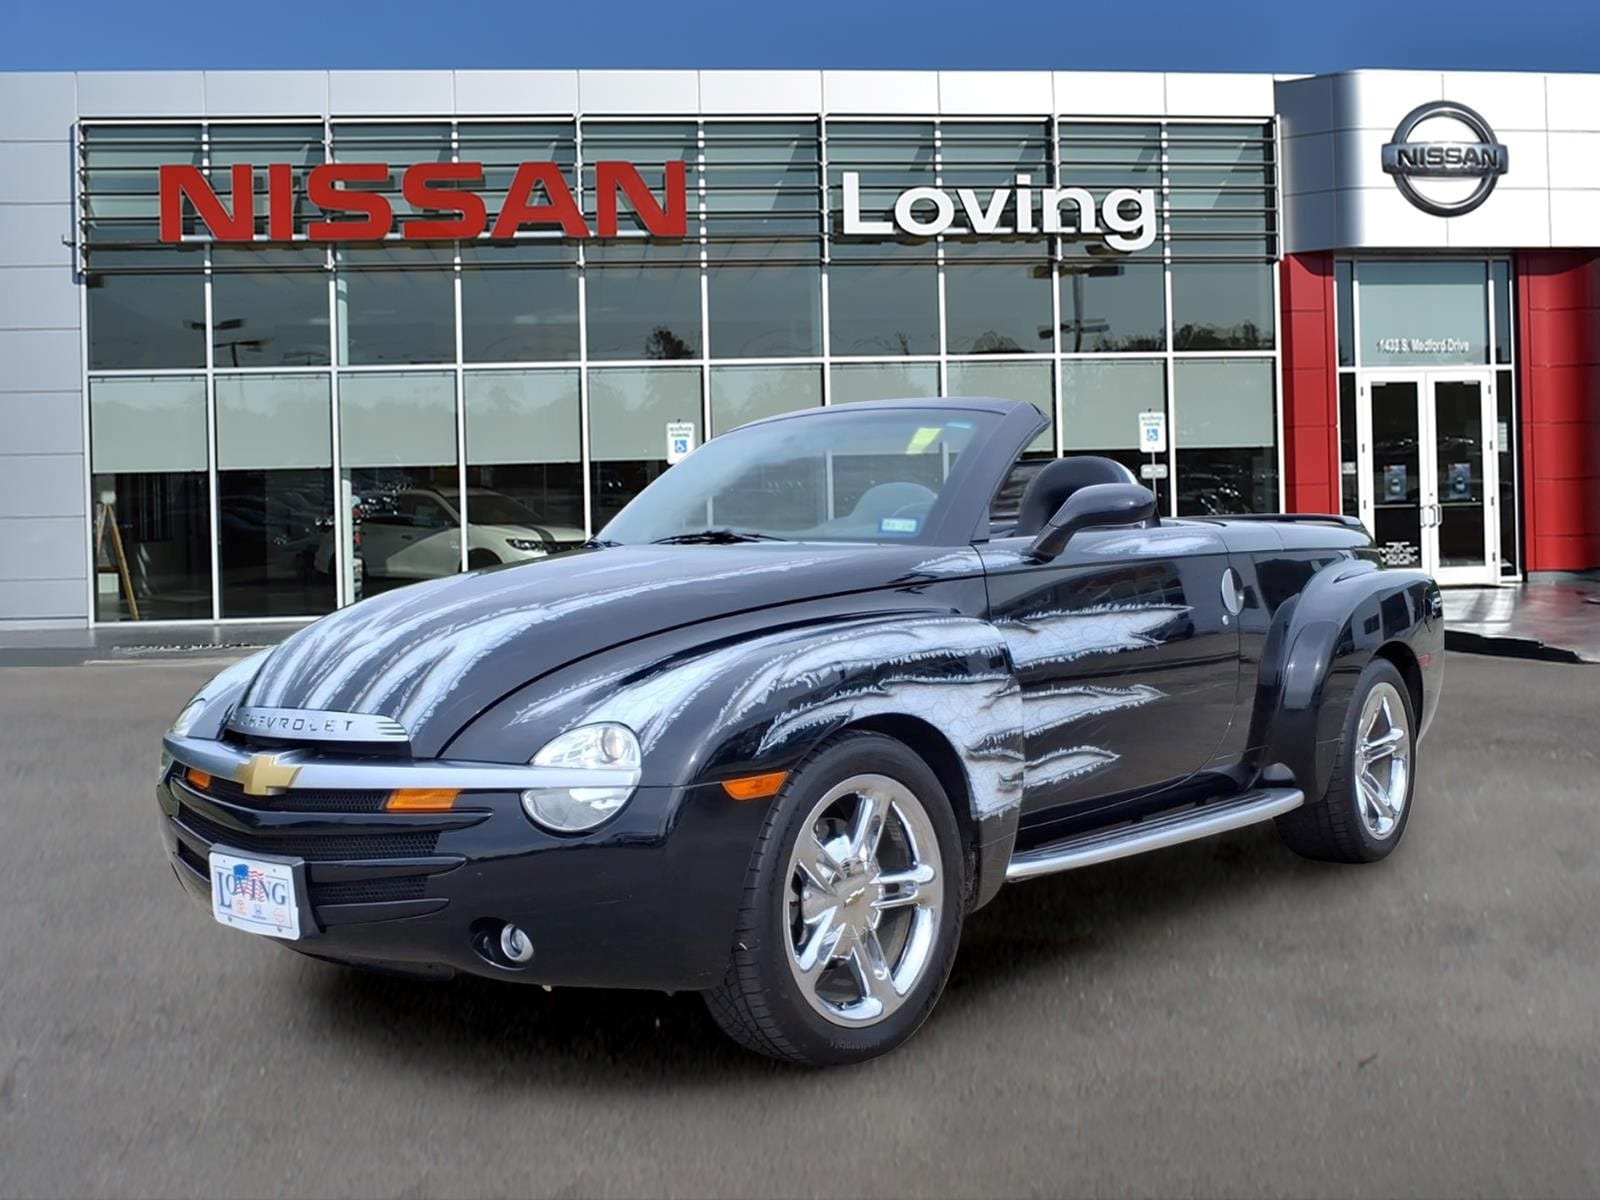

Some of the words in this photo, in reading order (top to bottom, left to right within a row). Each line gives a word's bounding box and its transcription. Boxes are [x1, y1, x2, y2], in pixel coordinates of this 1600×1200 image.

[1397, 147, 1498, 167] NISSAN
[159, 160, 687, 242] NISSAN
[842, 171, 1157, 251] Loving
[1379, 338, 1400, 353] 1433
[1411, 338, 1447, 353] Medford
[1447, 338, 1470, 353] Drive
[240, 712, 355, 733] CHEVROLET
[216, 871, 287, 908] LOVING
